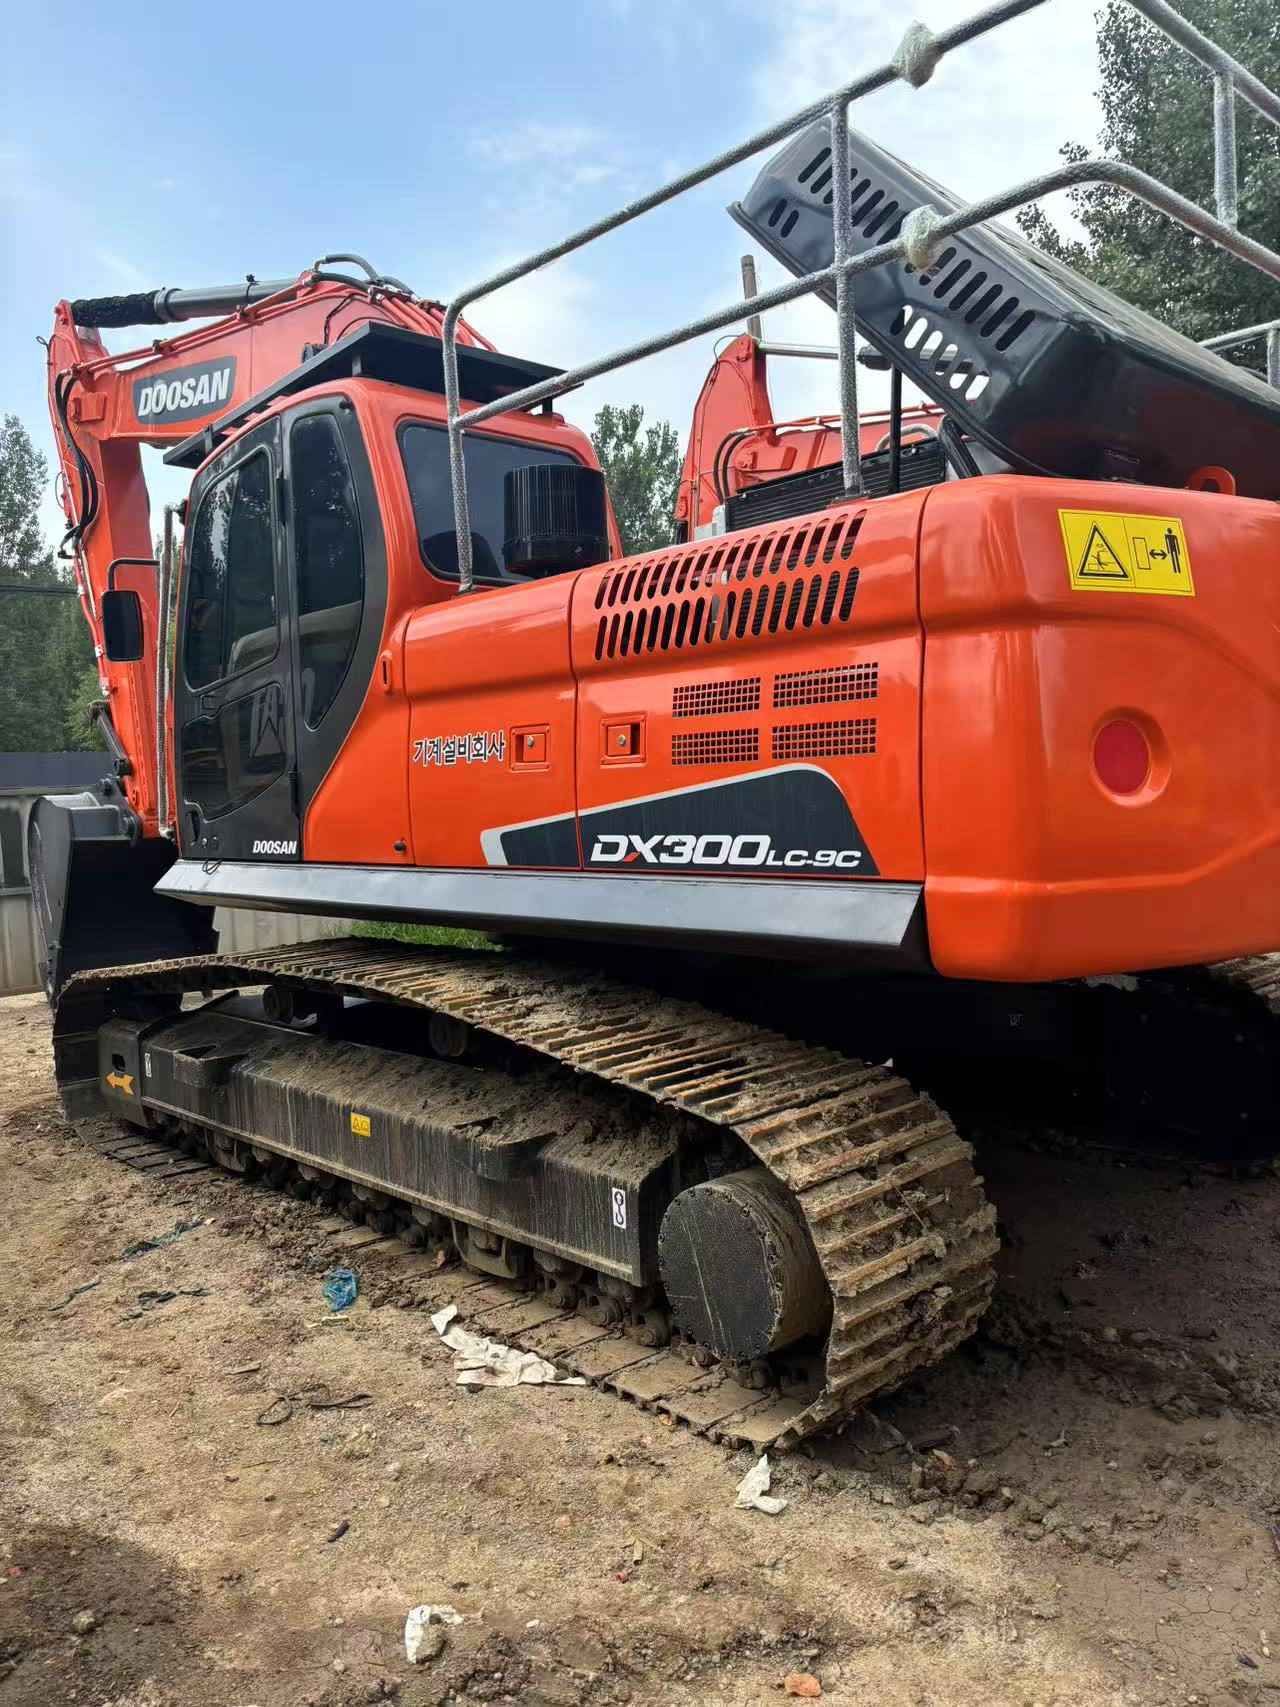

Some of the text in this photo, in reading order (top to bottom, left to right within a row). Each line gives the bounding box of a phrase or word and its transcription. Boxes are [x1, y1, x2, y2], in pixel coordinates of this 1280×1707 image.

[138, 368, 231, 416] DOOSAN
[413, 730, 506, 767] 기계설비회사
[252, 840, 298, 854] DOOSAN
